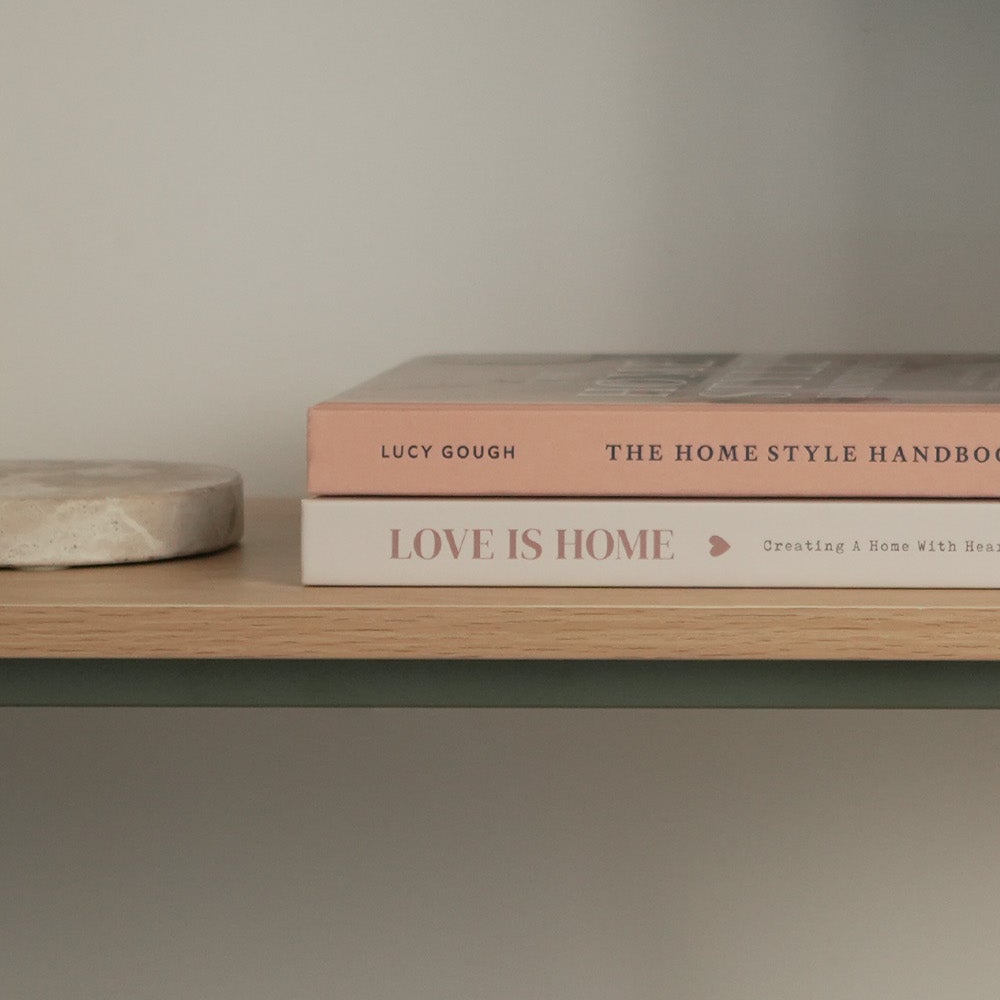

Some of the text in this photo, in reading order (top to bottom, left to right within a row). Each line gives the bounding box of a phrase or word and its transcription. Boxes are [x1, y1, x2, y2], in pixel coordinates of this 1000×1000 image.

[381, 444, 515, 460] LUCY GOUGH
[605, 443, 663, 462] THE
[674, 444, 758, 462] HOME
[767, 444, 857, 463] STYLE
[390, 528, 675, 561] LOVE IS HOME
[763, 538, 845, 554] Creating
[852, 540, 861, 552] A
[869, 539, 910, 552] Home
[917, 540, 957, 553] With
